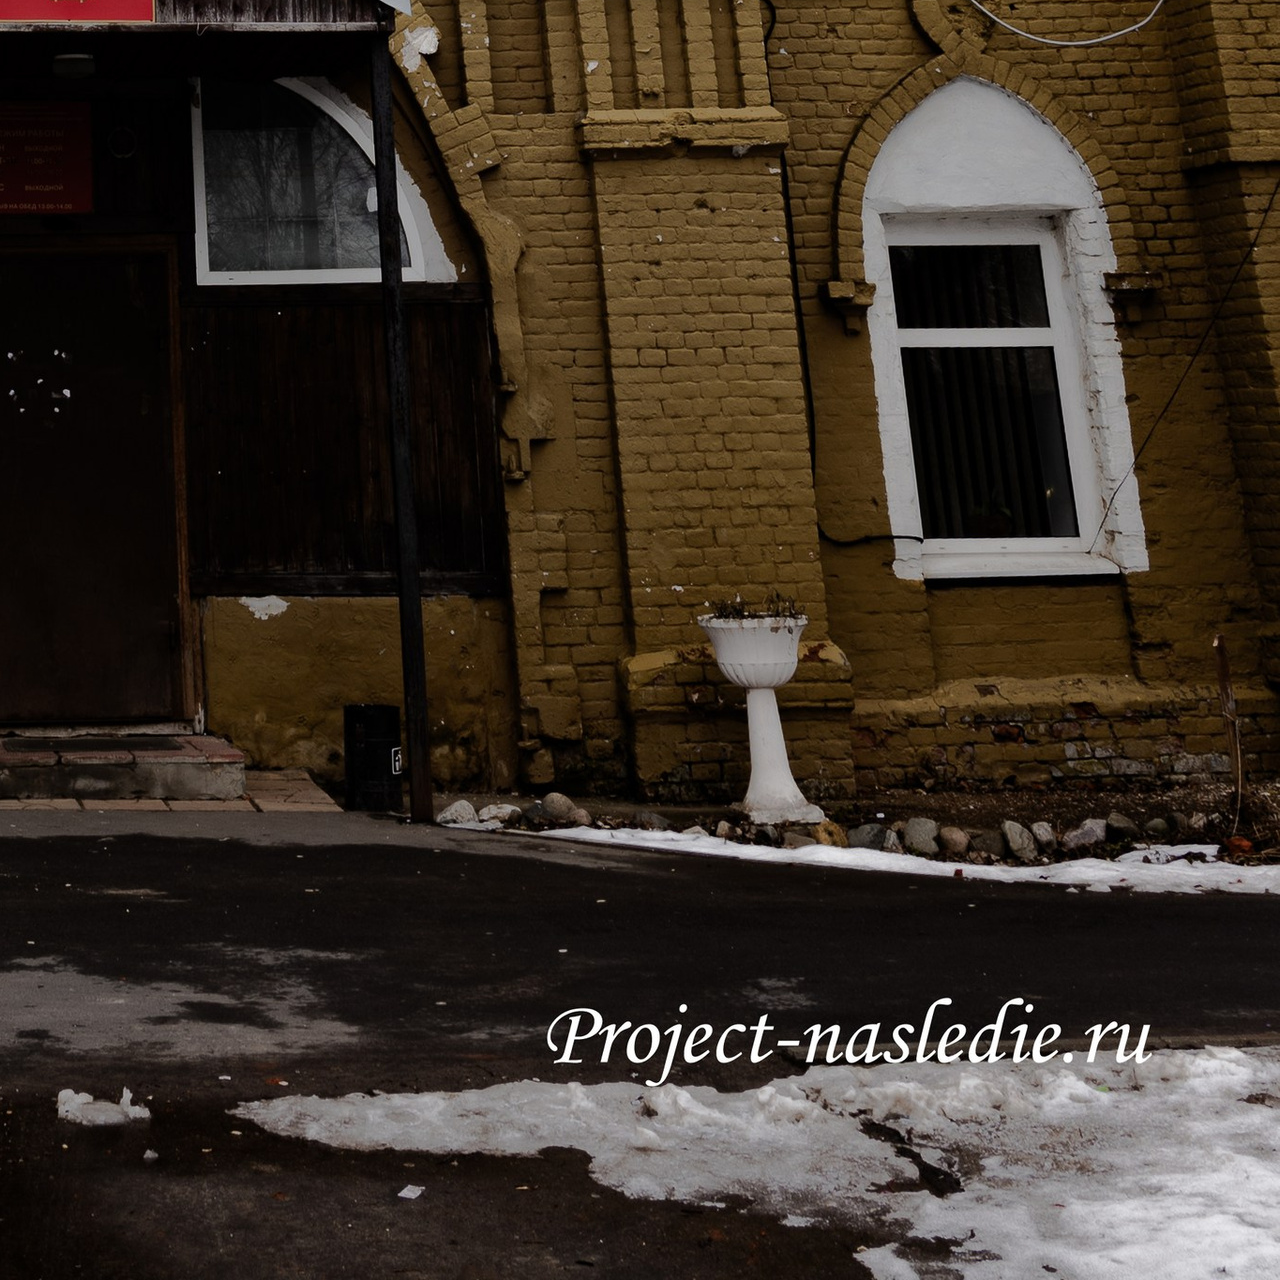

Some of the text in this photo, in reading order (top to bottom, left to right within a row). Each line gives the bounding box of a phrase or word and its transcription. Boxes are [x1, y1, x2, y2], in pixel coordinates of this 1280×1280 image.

[27, 129, 65, 138] РАБОТЫ
[24, 143, 64, 153] ВЫХОДНОЙ
[24, 183, 64, 192] ВЫХОДНОЙ
[8, 202, 19, 210] НА
[19, 202, 37, 211] ОБЕД
